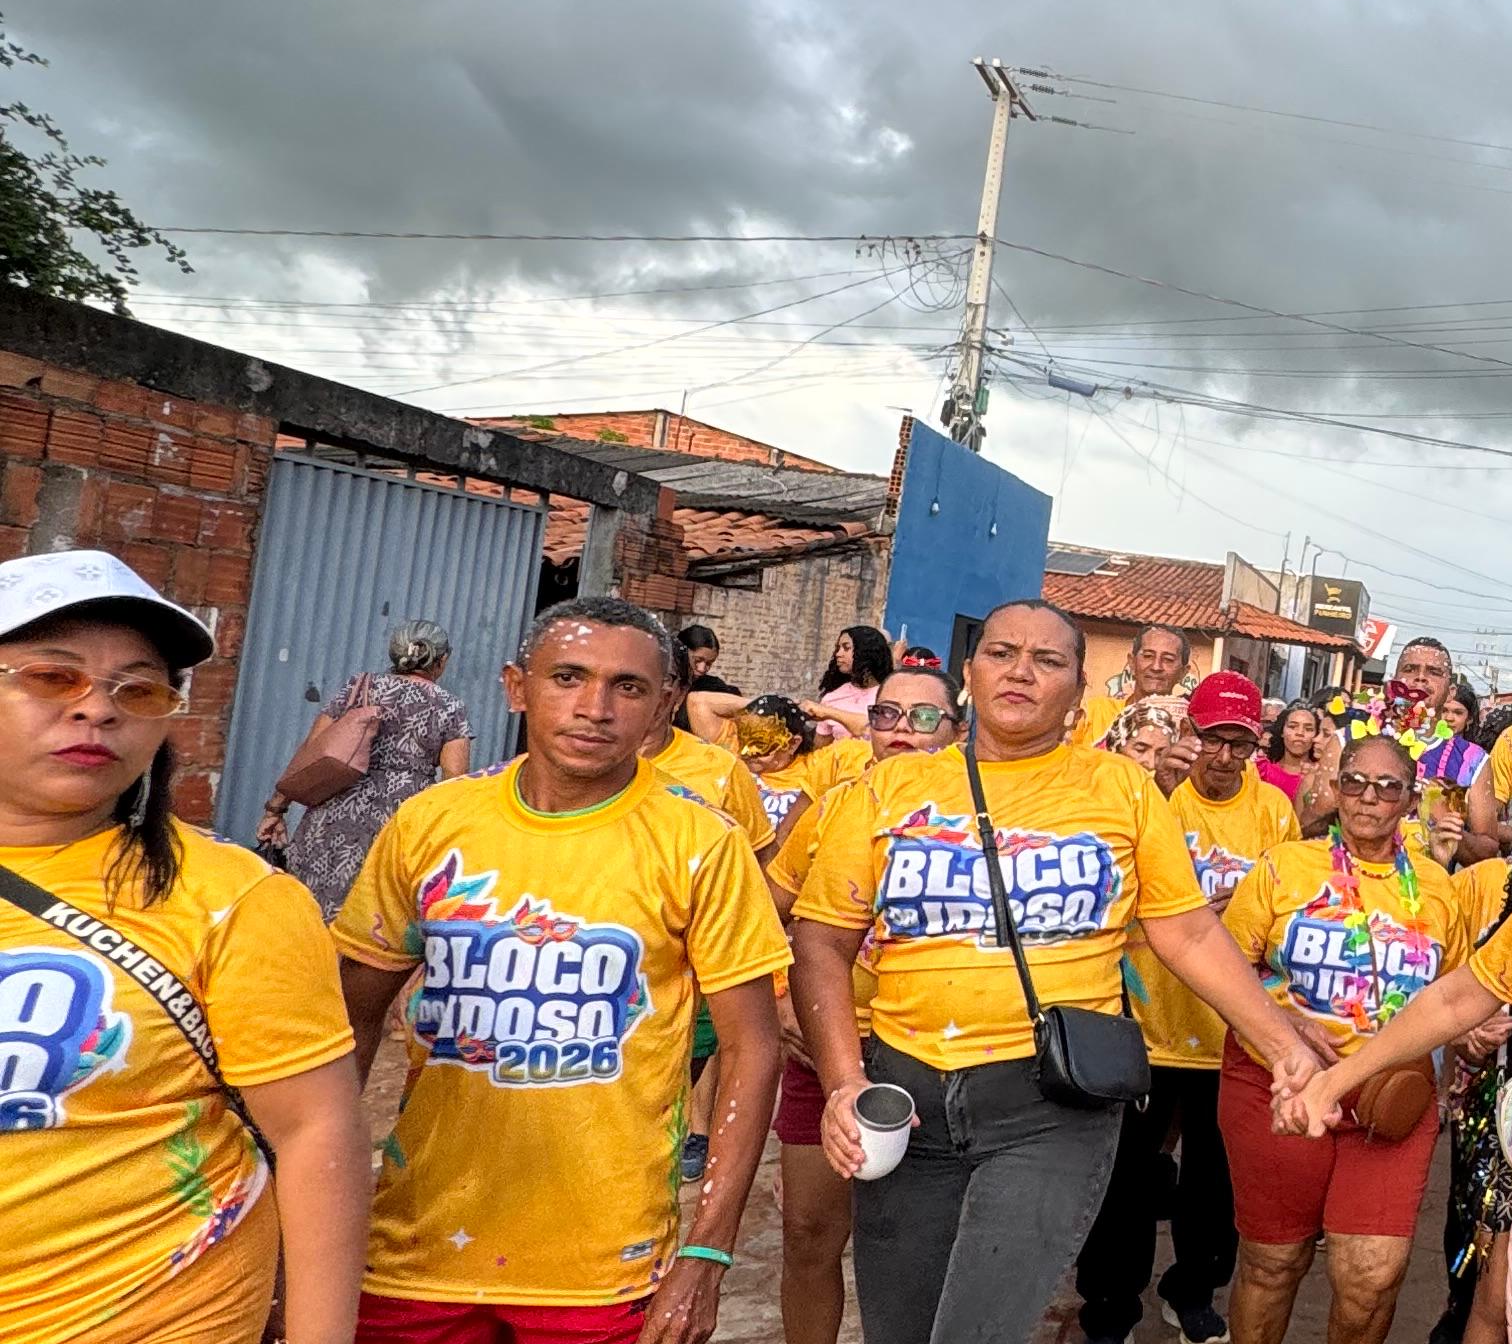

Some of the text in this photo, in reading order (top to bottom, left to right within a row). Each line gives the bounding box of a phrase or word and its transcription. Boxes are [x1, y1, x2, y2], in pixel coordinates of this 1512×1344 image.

[424, 936, 627, 995] BLOCO
[437, 994, 614, 1042] IDOSO
[498, 1040, 619, 1080] 2026
